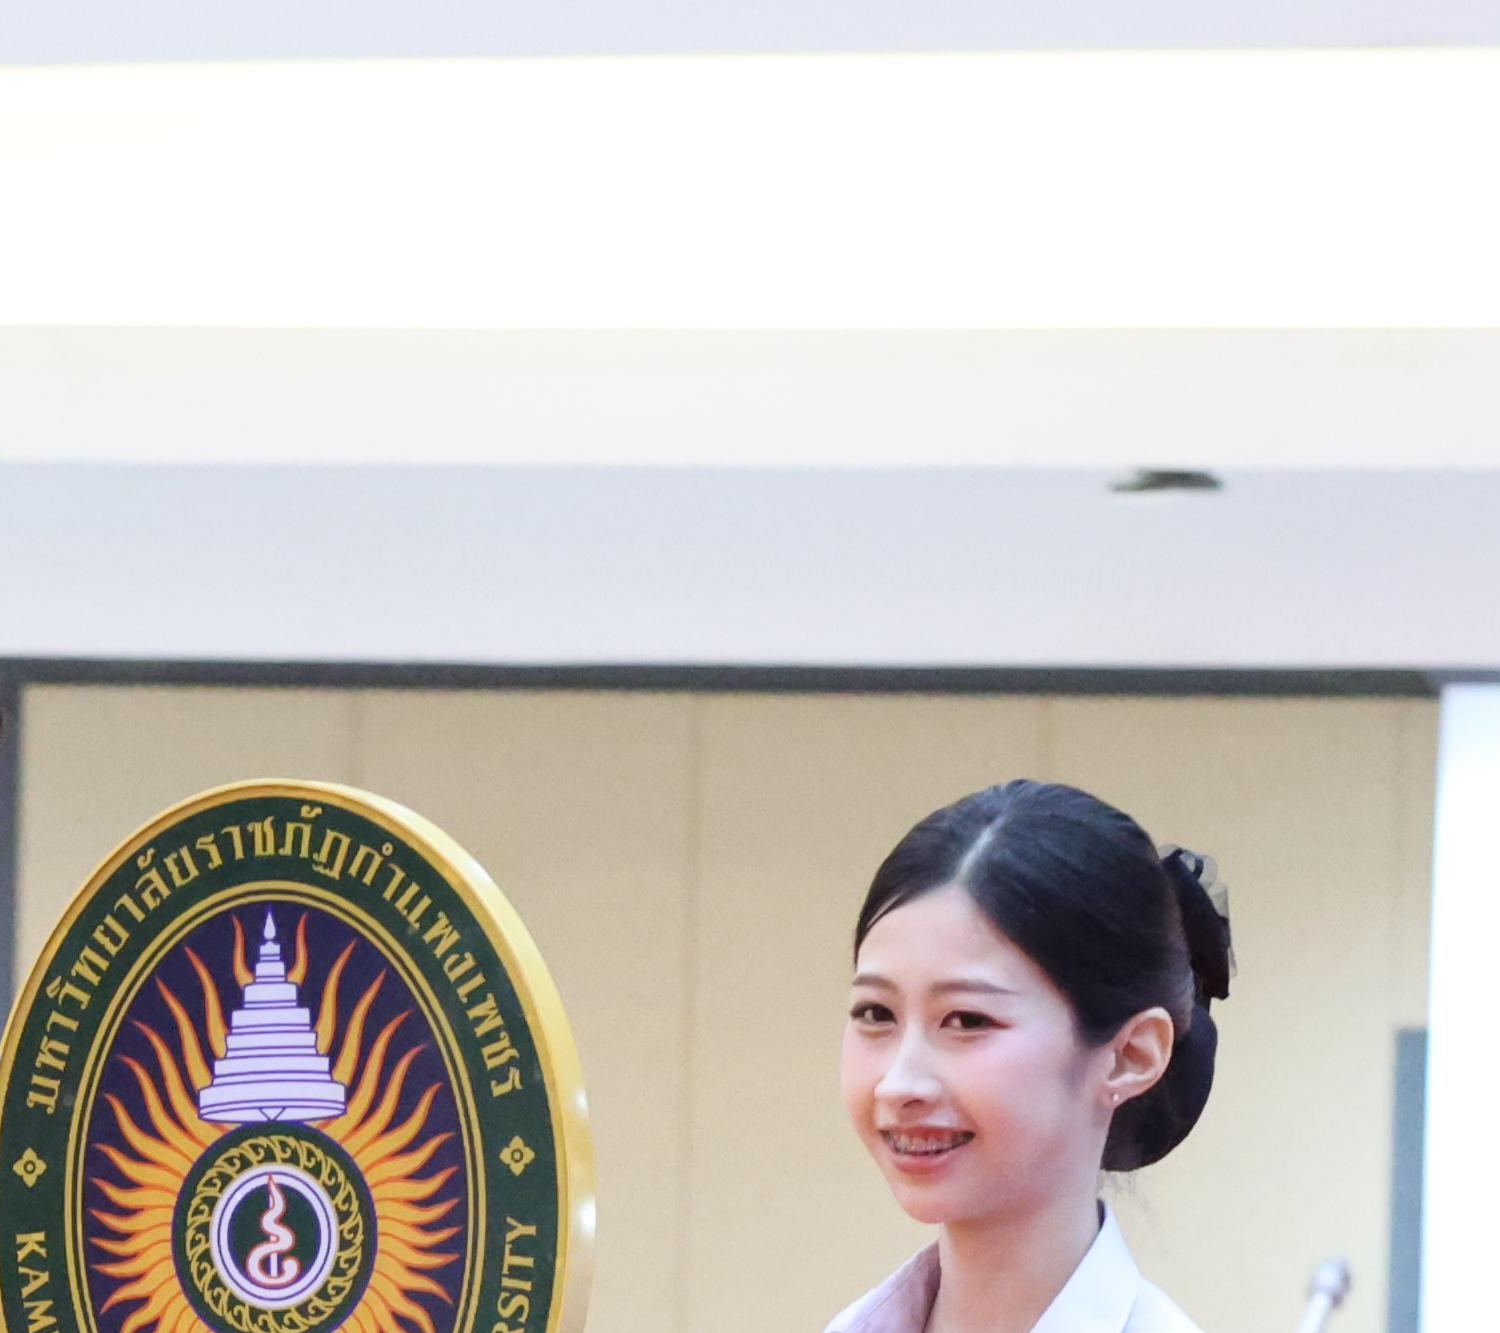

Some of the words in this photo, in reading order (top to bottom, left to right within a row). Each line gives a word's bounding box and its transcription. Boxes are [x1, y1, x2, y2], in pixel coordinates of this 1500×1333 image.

[25, 805, 523, 1114] มหาวิทยาลัยราชภัฏกำแพงเพชร
